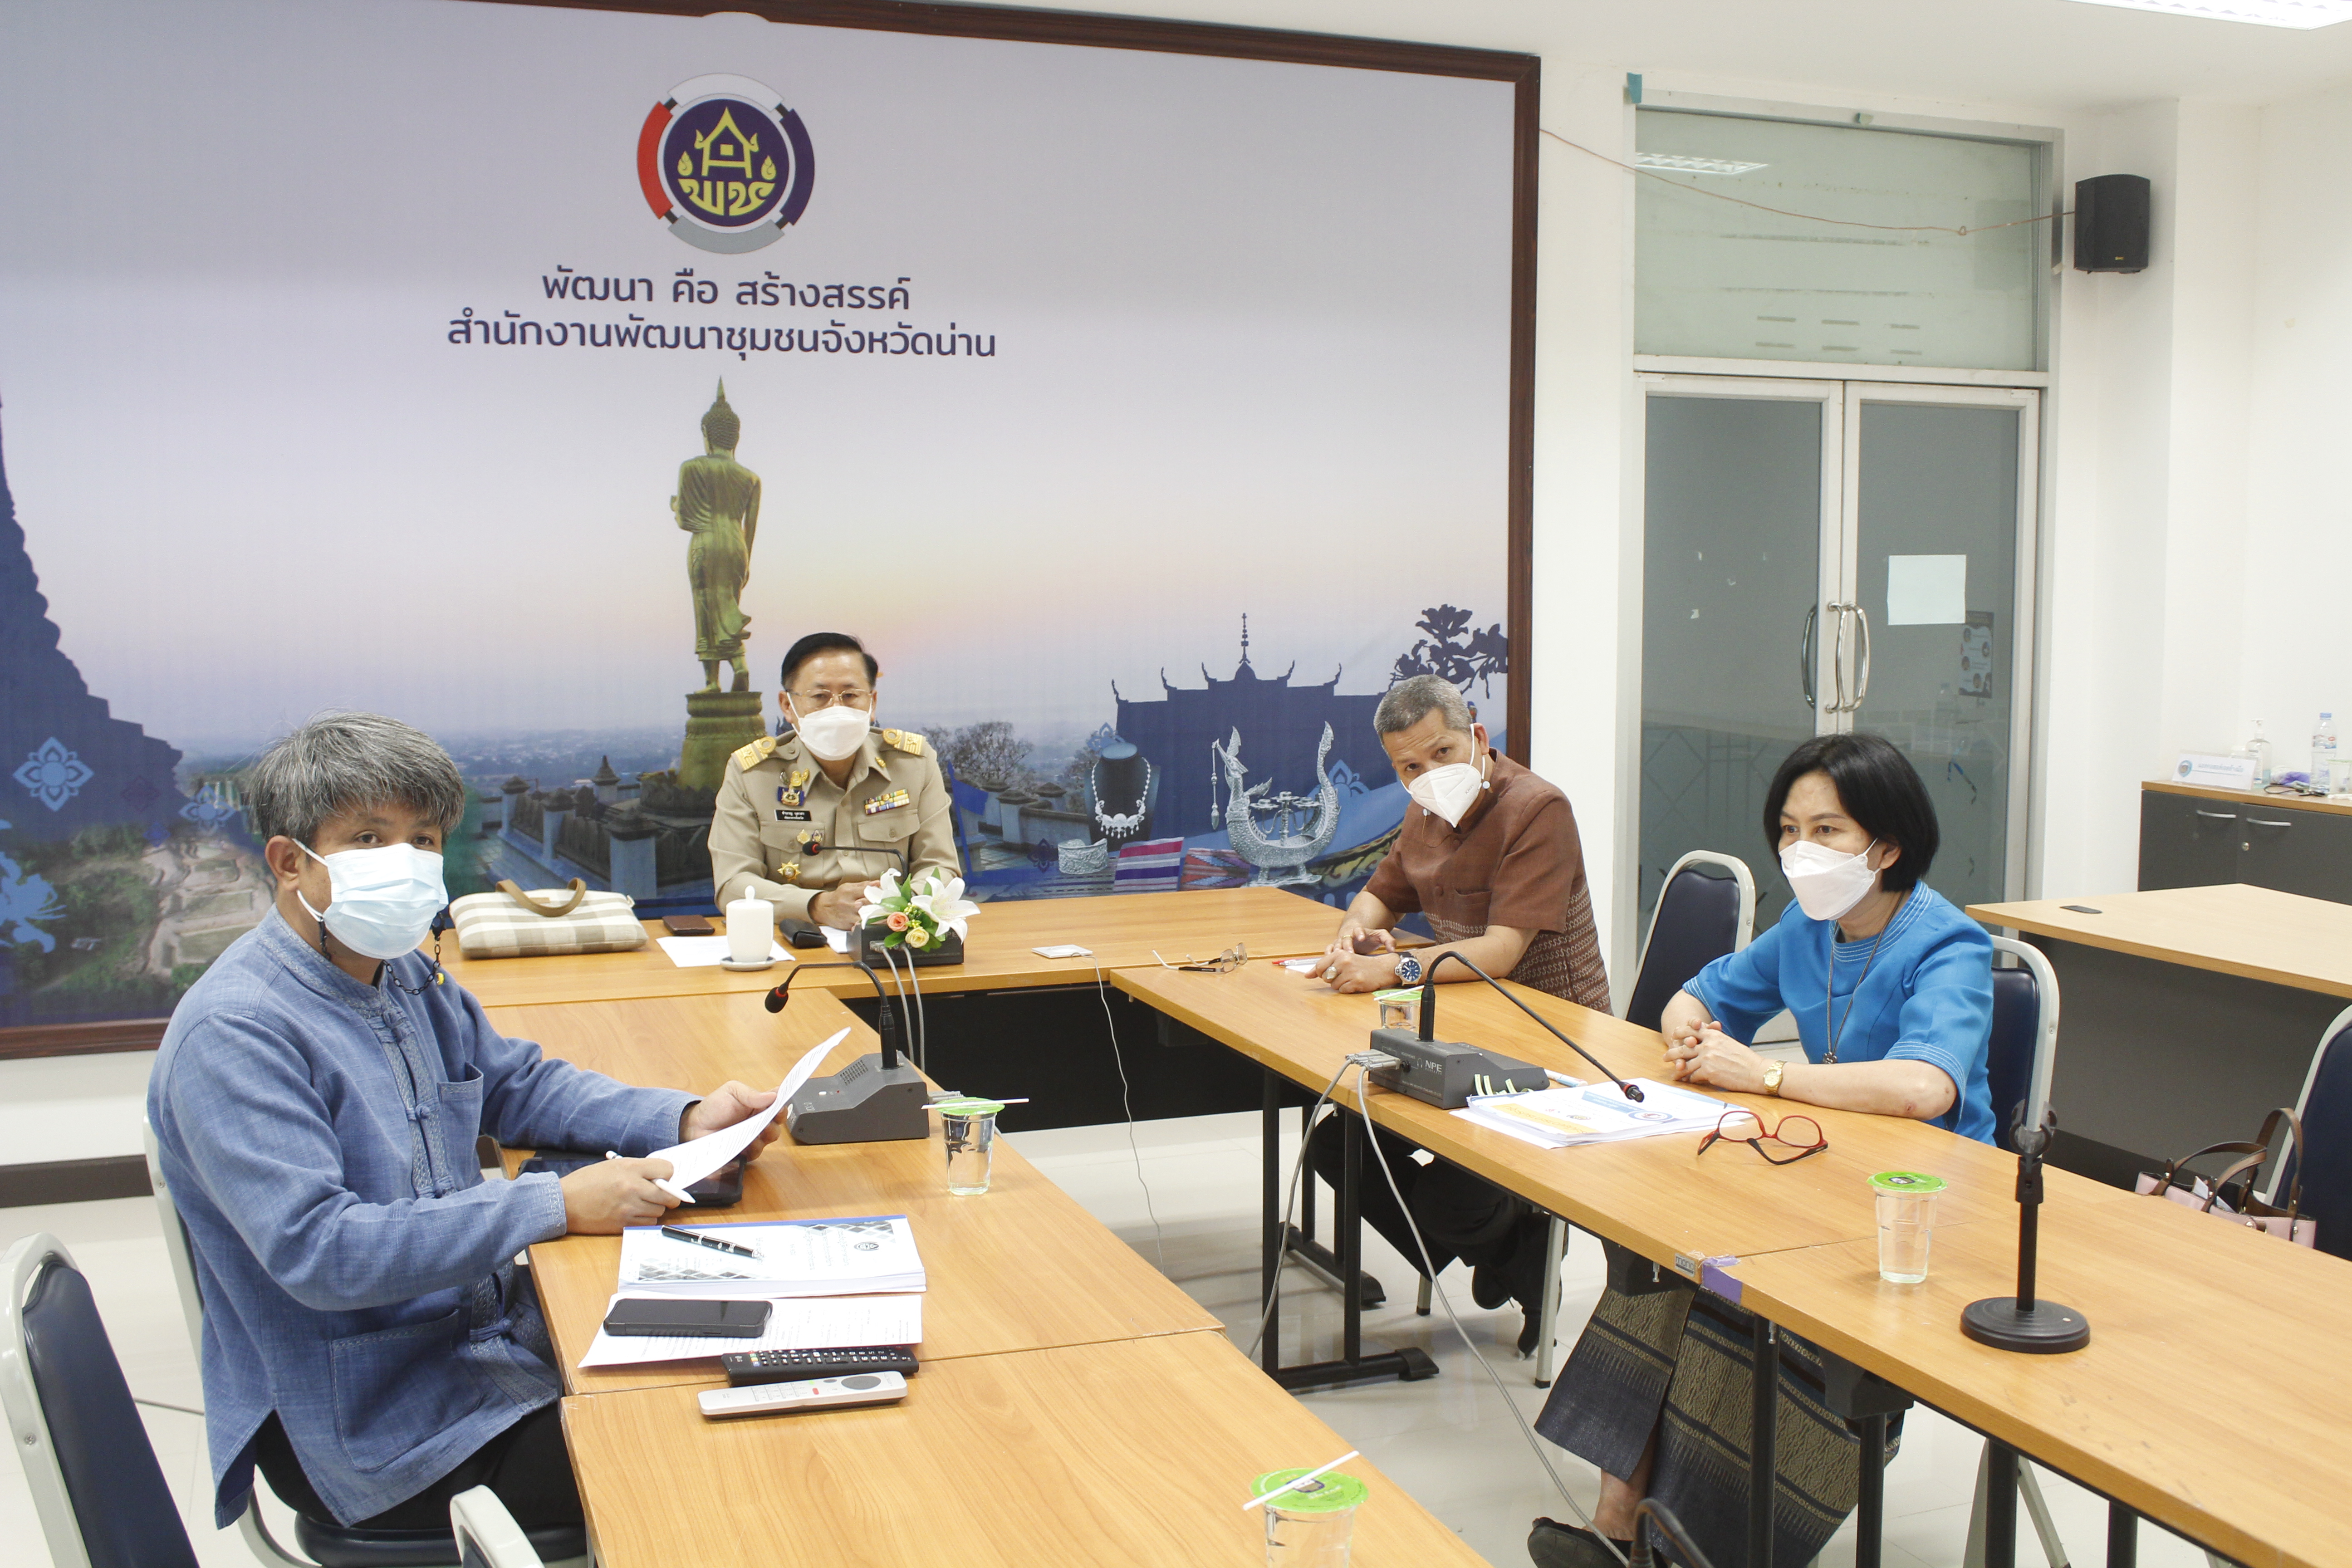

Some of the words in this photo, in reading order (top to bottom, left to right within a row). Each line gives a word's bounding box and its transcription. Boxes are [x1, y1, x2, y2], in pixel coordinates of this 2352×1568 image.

[542, 265, 653, 302] พัฒนา
[673, 268, 719, 304] คือ
[736, 271, 911, 310] สร้างสรรค์
[448, 307, 995, 361] สำนักงานพัฒนาชุมชนจังหวัดน่าน
[1425, 1060, 1442, 1073] NPE
[1675, 1256, 1694, 1270] mono
